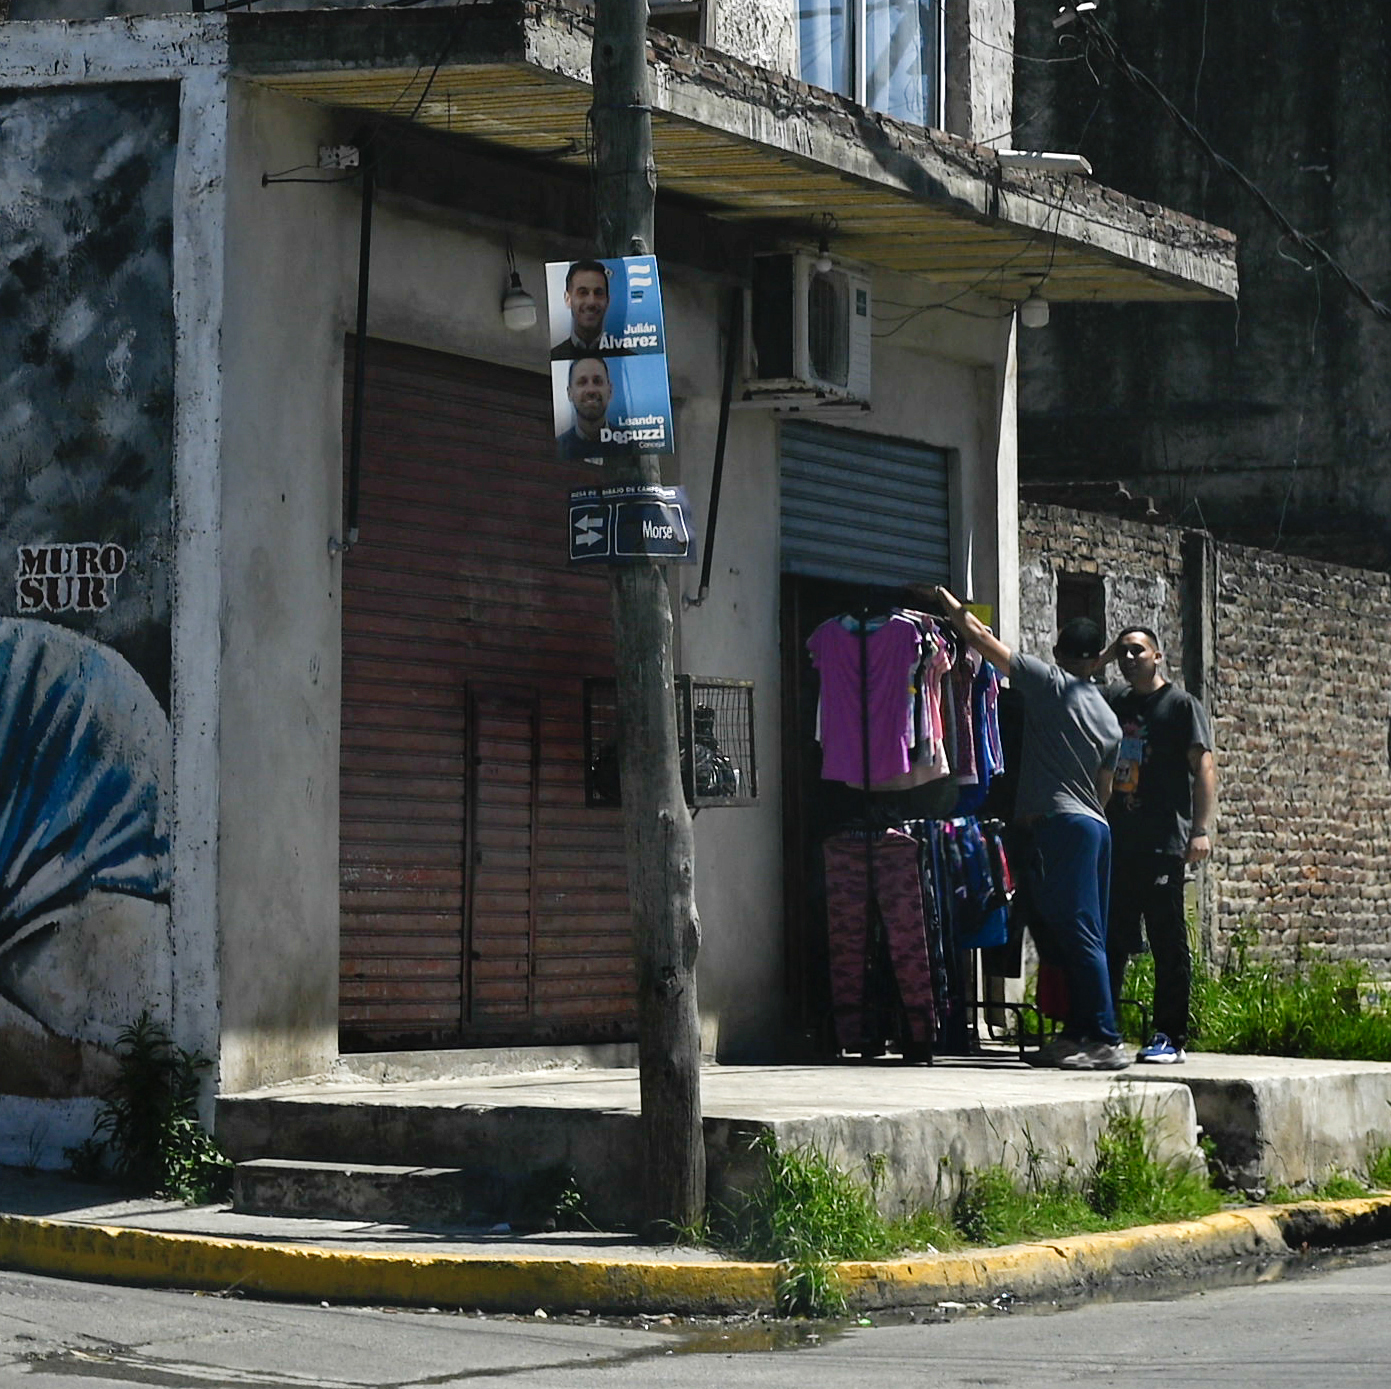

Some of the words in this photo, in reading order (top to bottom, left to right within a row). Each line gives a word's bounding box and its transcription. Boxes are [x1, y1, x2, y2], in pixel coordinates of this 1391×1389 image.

[623, 322, 657, 334] Julián
[599, 332, 658, 350] Álvarez
[618, 414, 665, 426] Leandro
[642, 520, 673, 539] Morse
[19, 545, 125, 575] MURO
[18, 576, 108, 609] SUR
